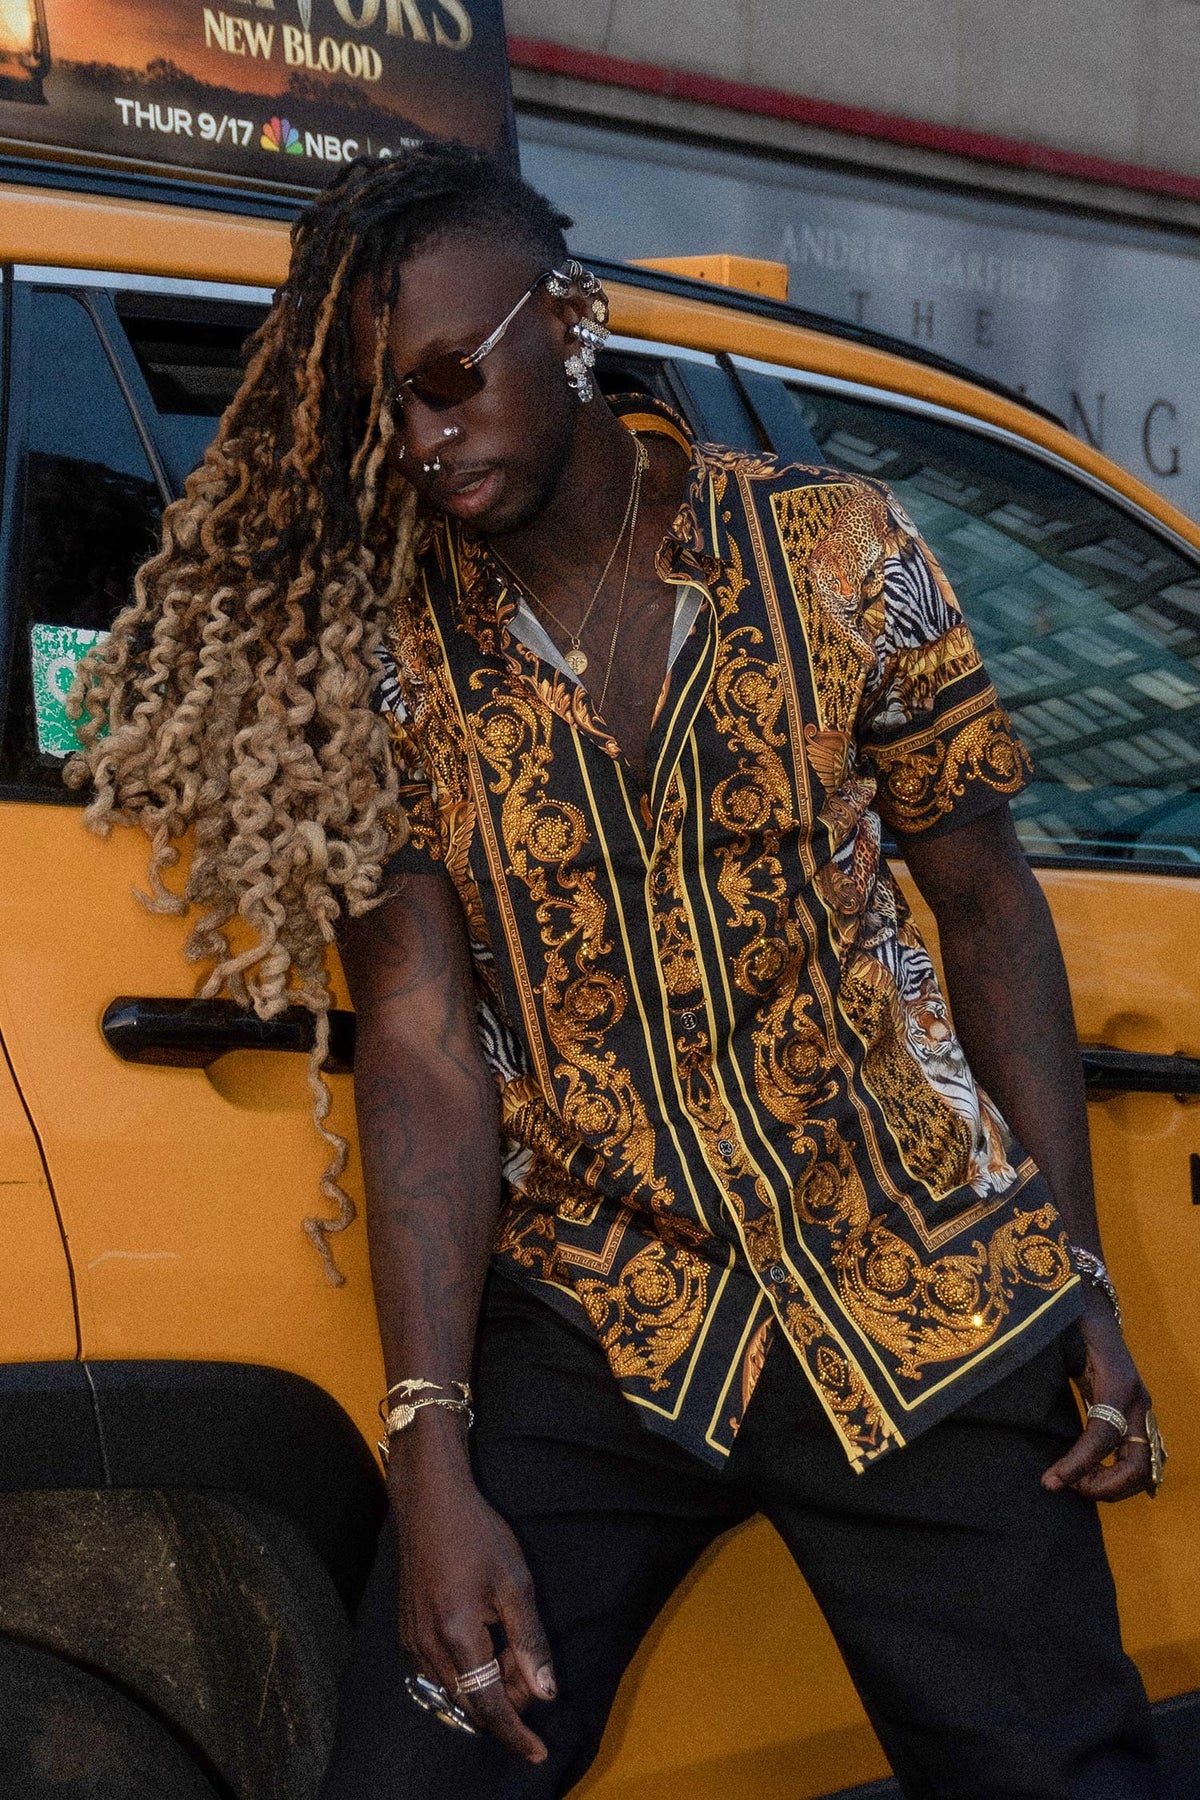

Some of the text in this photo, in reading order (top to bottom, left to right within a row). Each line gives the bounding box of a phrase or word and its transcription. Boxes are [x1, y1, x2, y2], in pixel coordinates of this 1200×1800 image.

[203, 7, 275, 61] NEW
[282, 23, 384, 83] BLOOD
[114, 97, 359, 162] THUR 9/17 NBC
[850, 289, 994, 348] THE
[1016, 383, 1178, 478] NG
